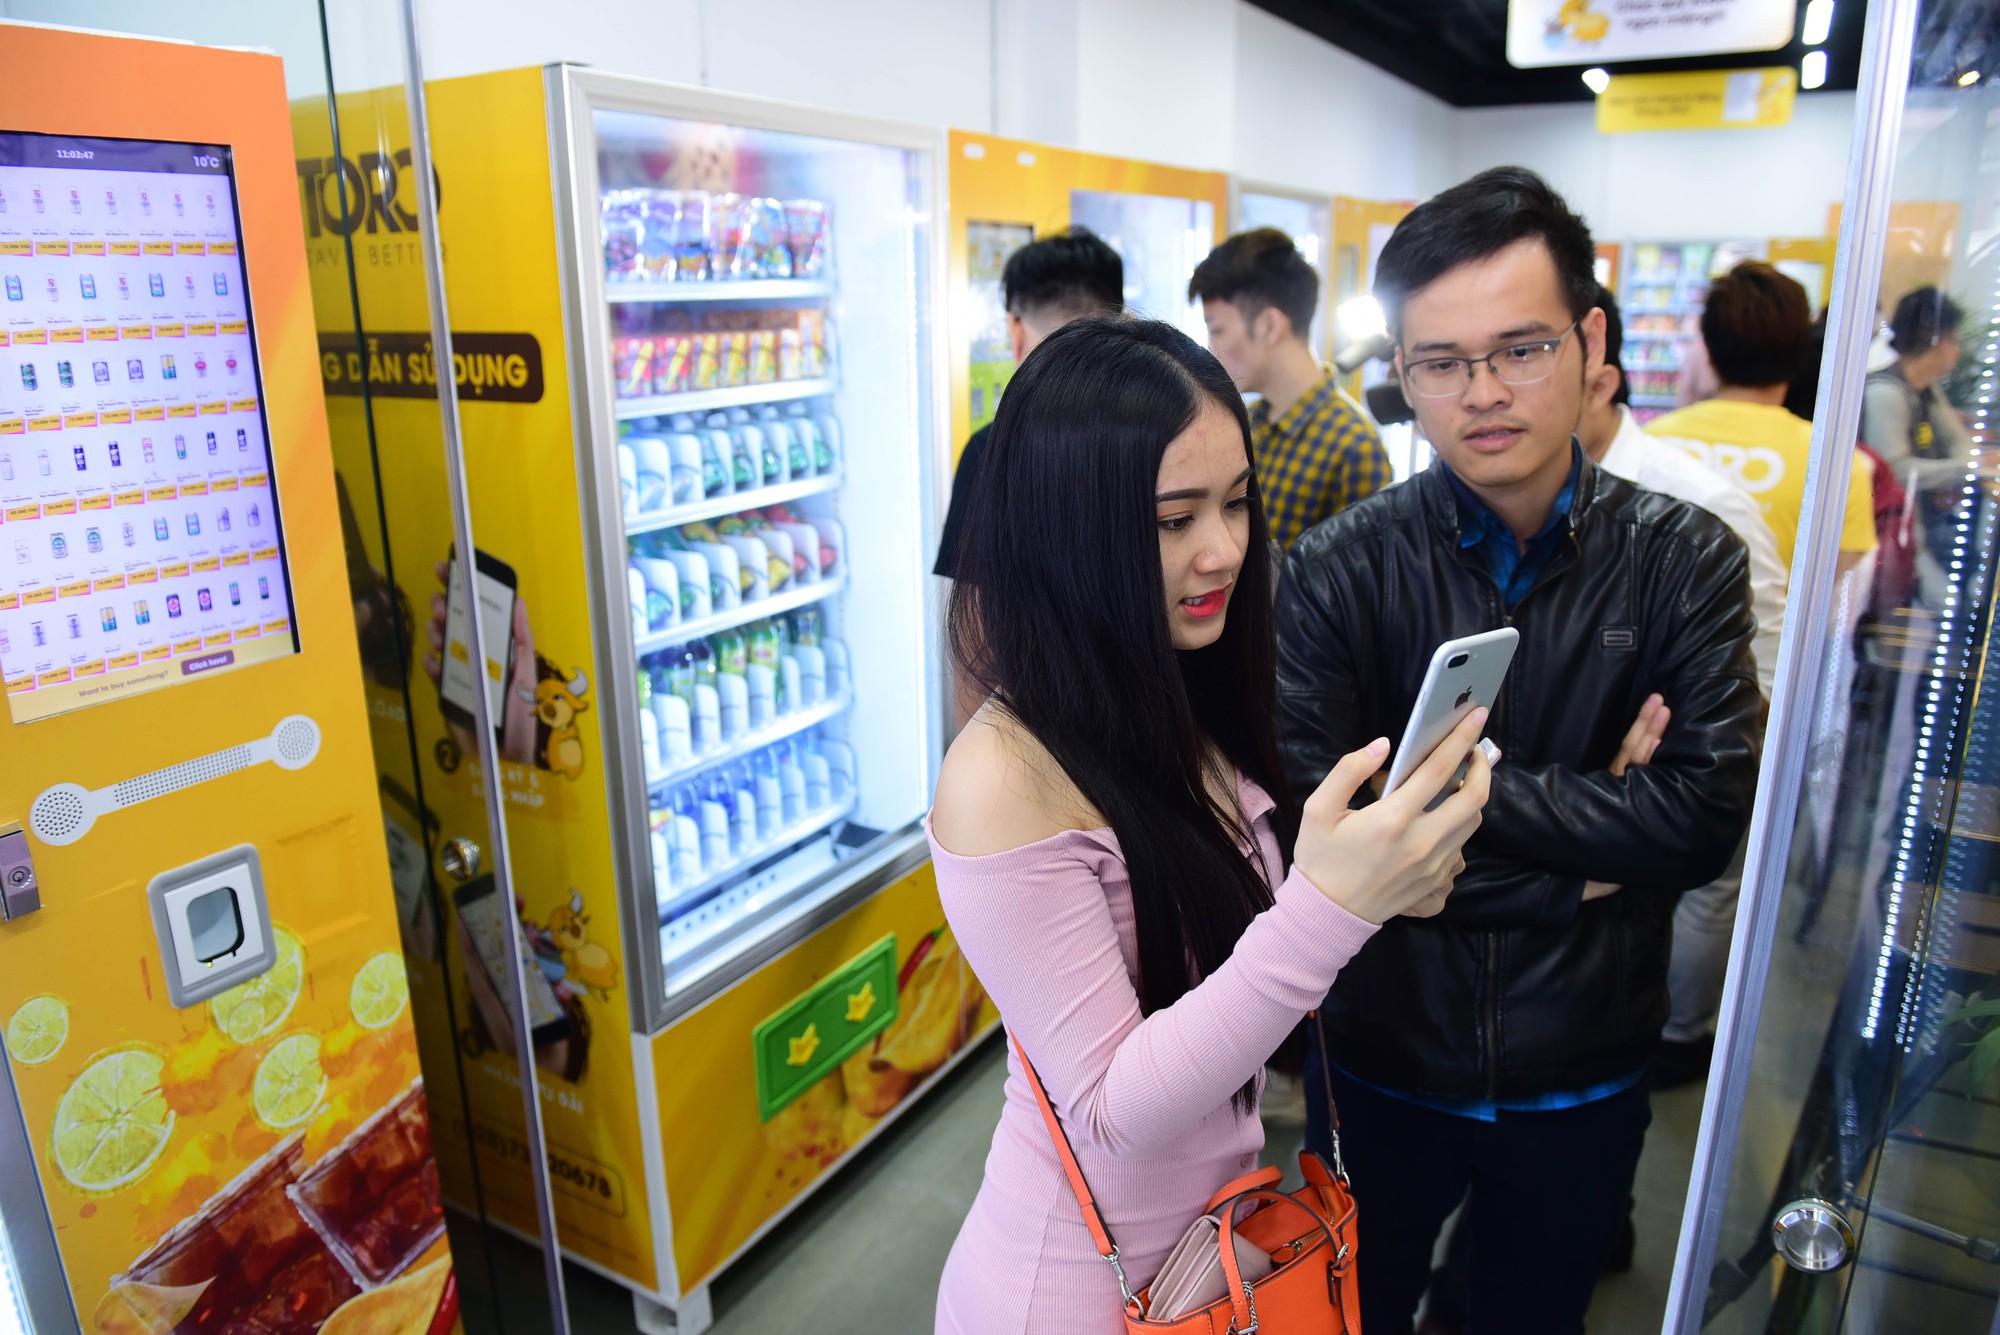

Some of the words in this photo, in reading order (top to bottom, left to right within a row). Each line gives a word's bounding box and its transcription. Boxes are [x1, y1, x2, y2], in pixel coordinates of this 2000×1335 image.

[56, 149, 94, 160] 11:03:47
[193, 155, 220, 168] 10°C
[189, 659, 208, 671] Click
[79, 686, 99, 697] Want
[101, 685, 109, 693] to
[110, 681, 125, 691] buy
[127, 670, 169, 686] something?
